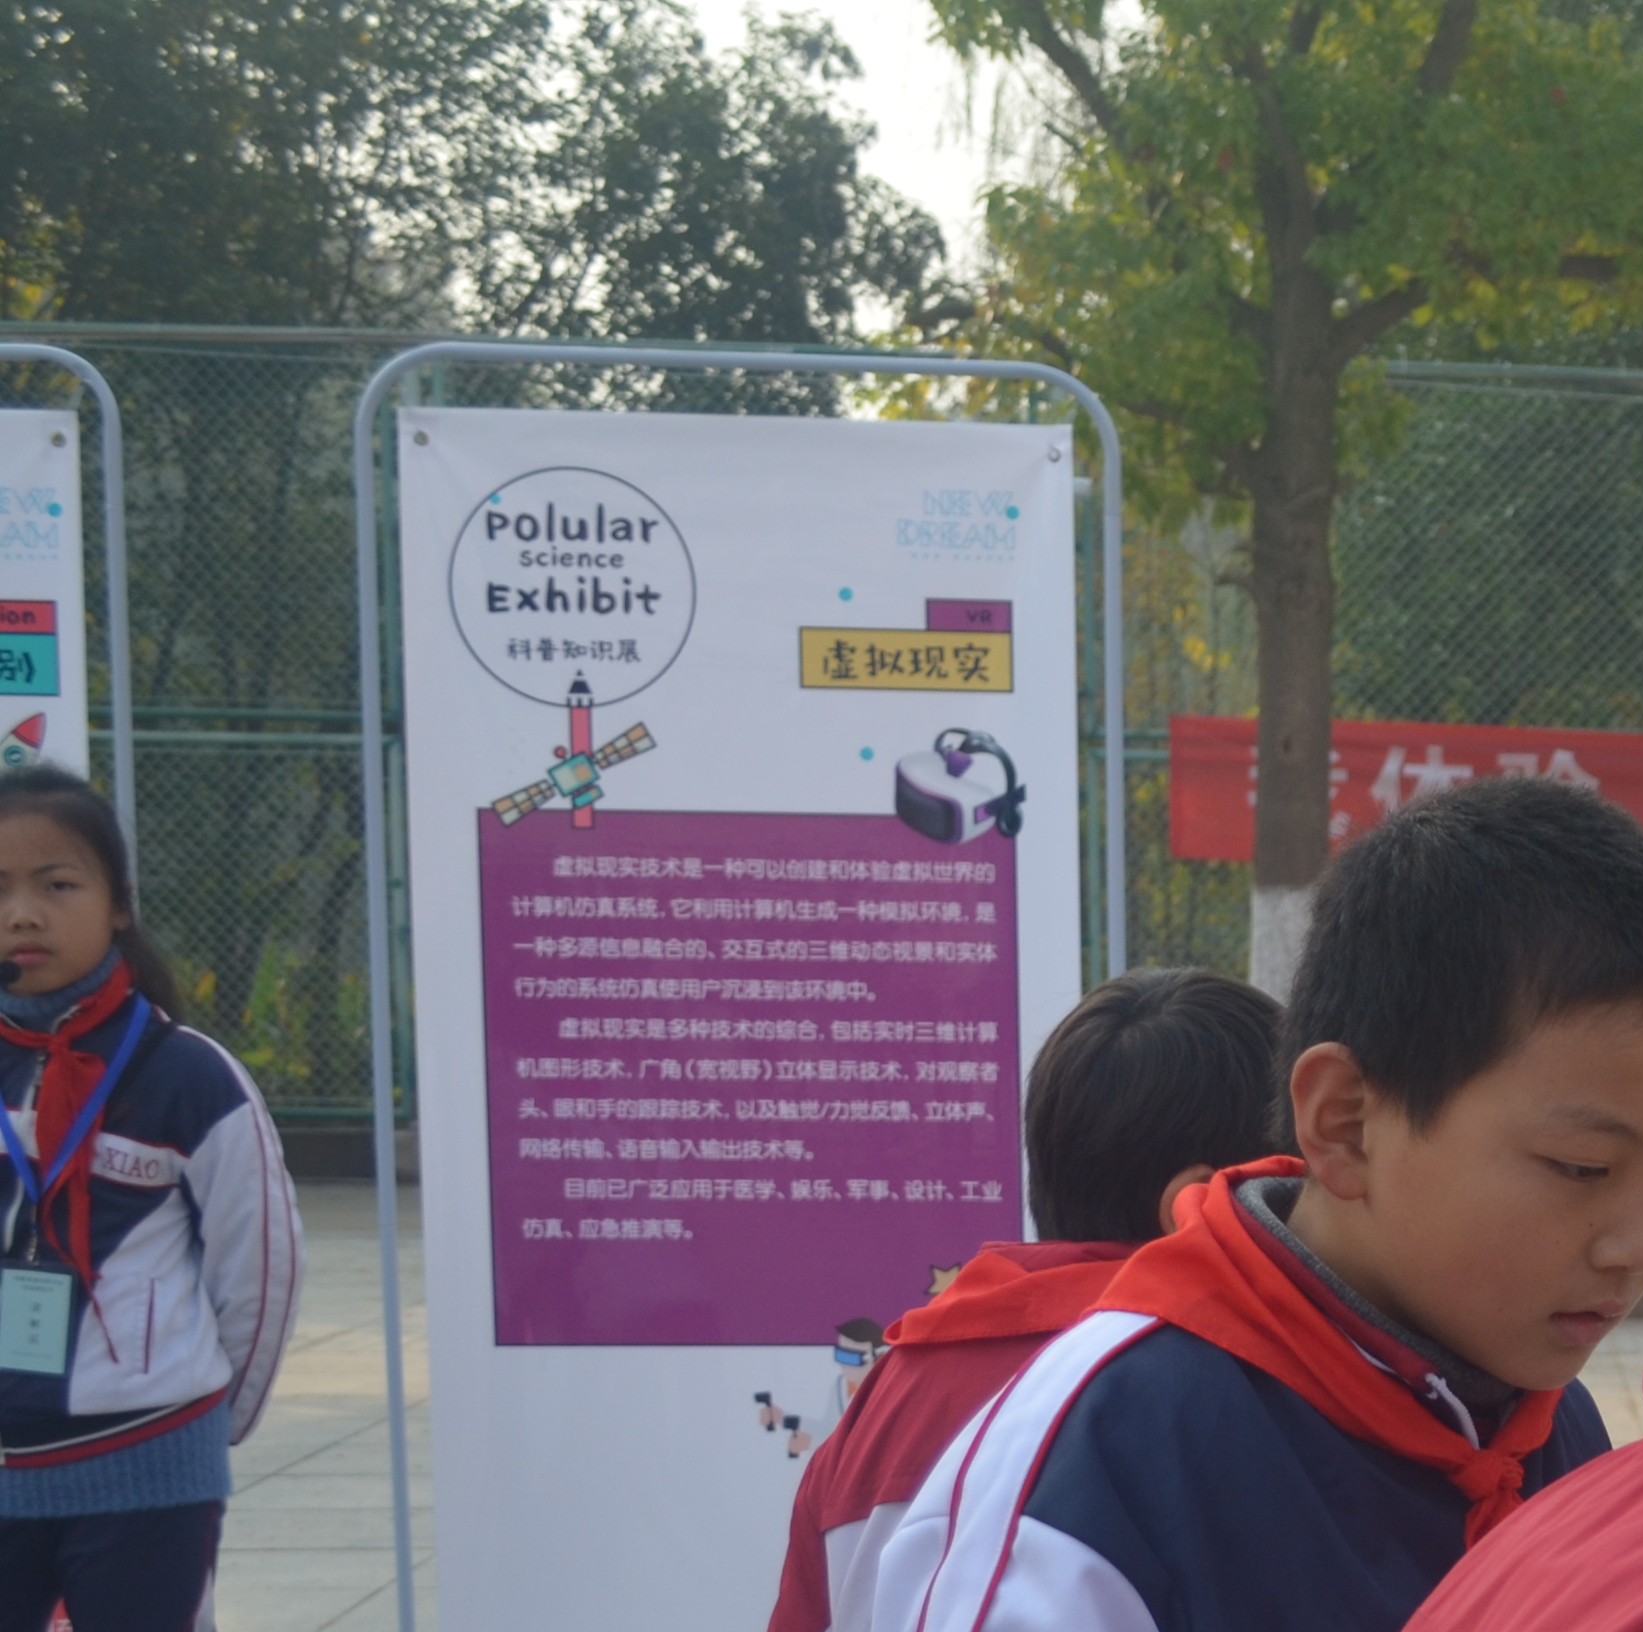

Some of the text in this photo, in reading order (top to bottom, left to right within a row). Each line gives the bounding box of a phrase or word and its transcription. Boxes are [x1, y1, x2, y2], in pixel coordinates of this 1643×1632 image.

[519, 546, 625, 569] science
[486, 576, 662, 615] Exhibit
[966, 609, 993, 624] VR
[507, 638, 641, 662] 科普知识展
[823, 639, 991, 683] 虚拟现实
[103, 1146, 160, 1180] XIAO
